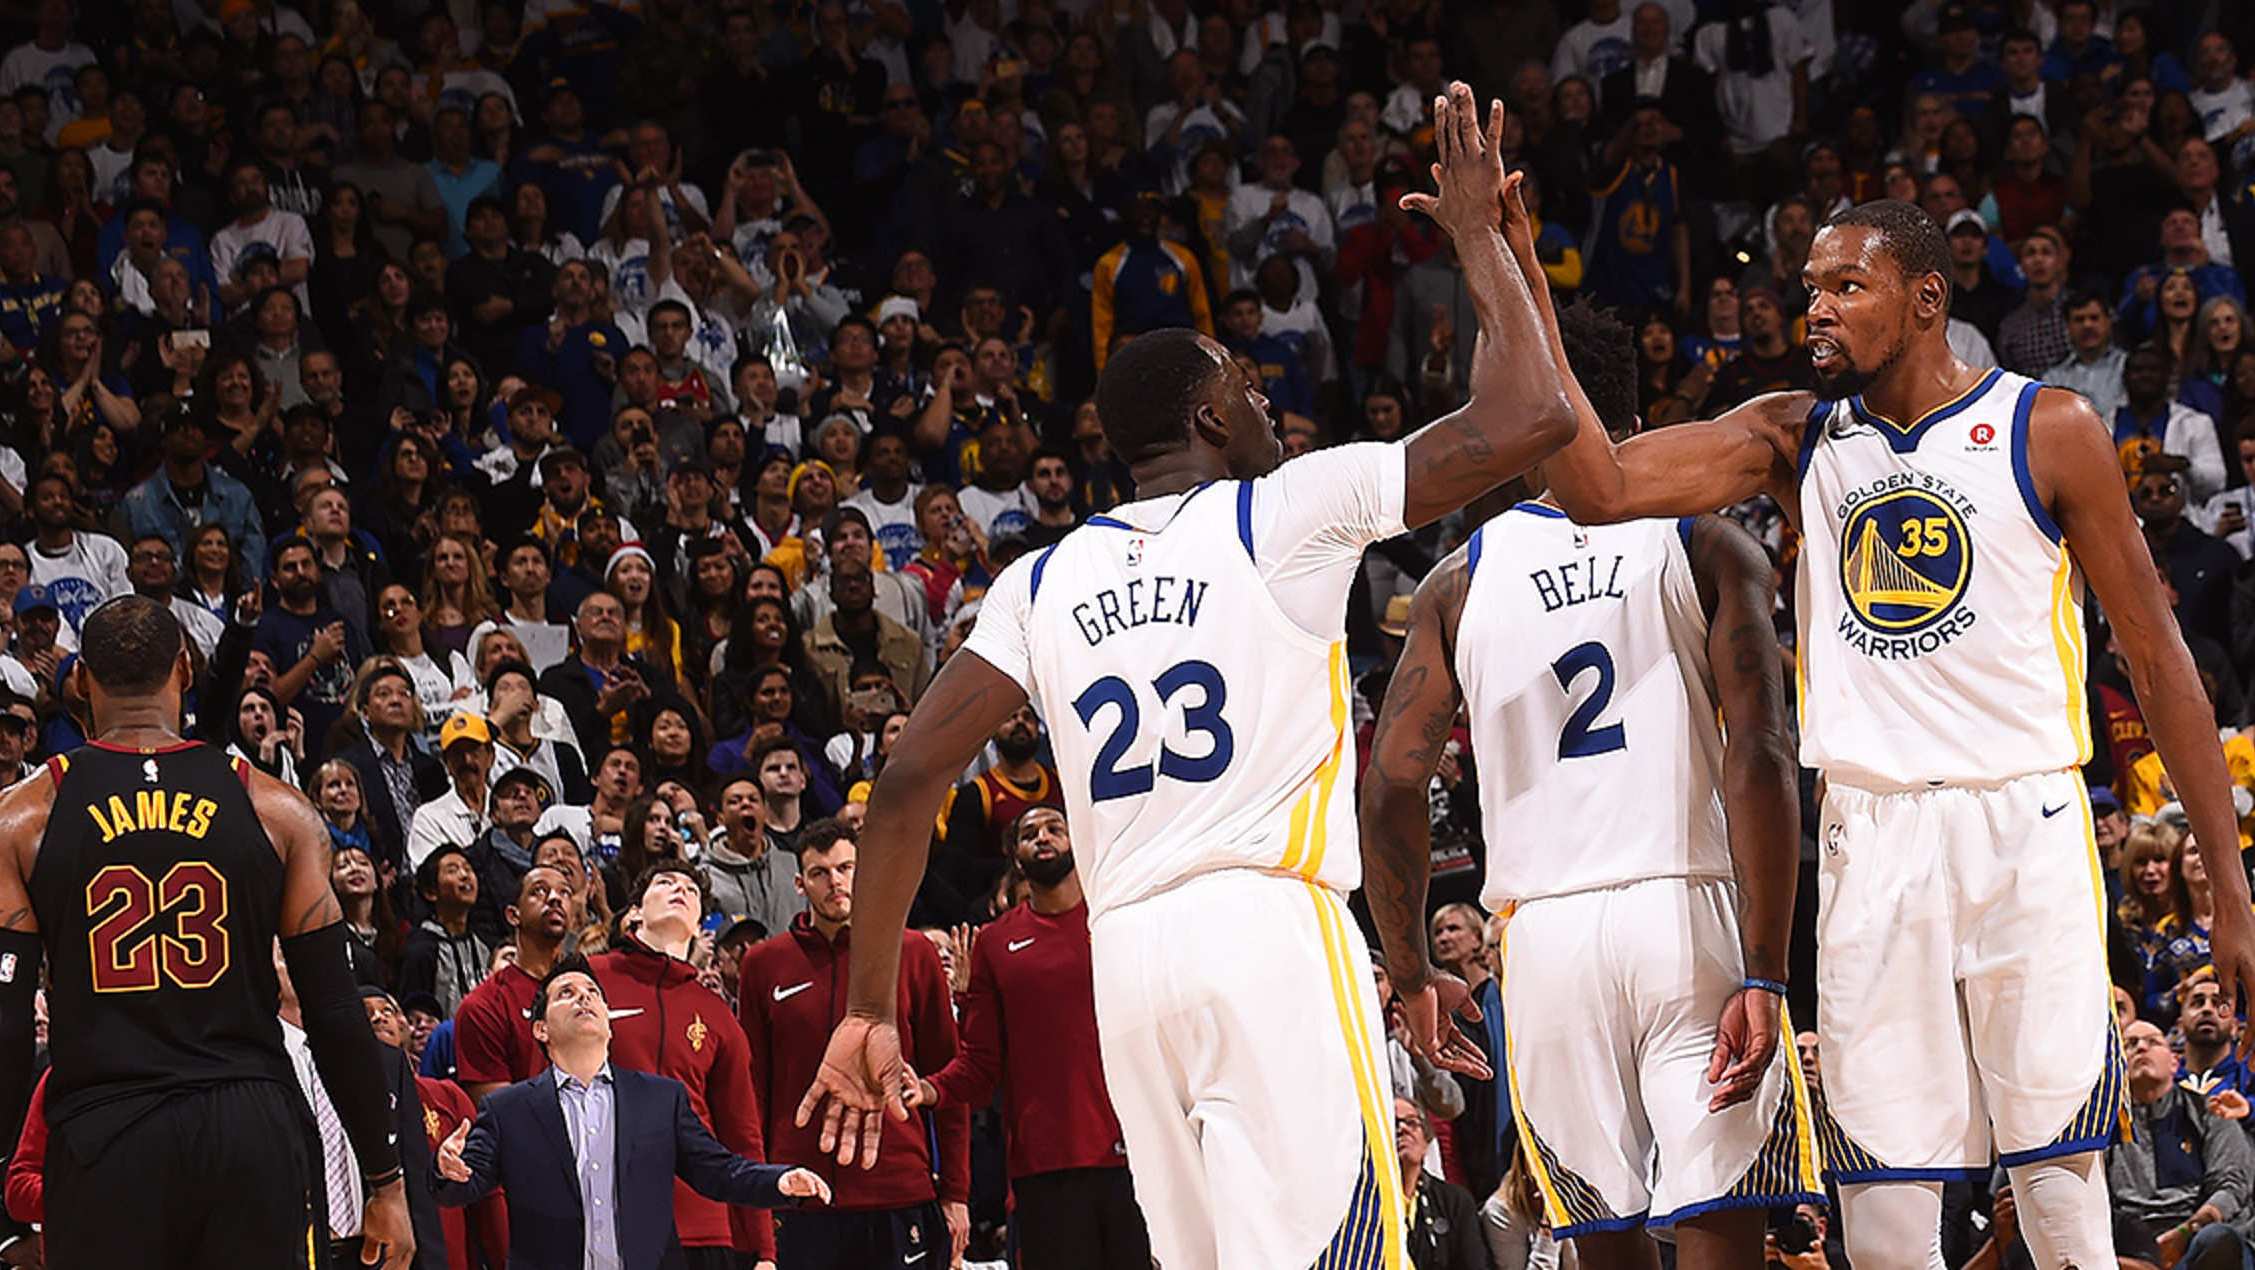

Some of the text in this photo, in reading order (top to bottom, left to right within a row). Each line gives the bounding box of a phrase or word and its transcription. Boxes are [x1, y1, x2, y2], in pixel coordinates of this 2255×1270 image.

[1836, 472, 1978, 520] GOLDEN STATE
[1896, 516, 1949, 558] 35
[1071, 576, 1210, 647] GREEN
[1529, 555, 1625, 613] BELL
[1837, 605, 1977, 661] WARRIORS
[1550, 640, 1628, 763] 2
[1070, 659, 1235, 807] 23
[86, 789, 219, 844] JAMES
[85, 861, 230, 993] 23
